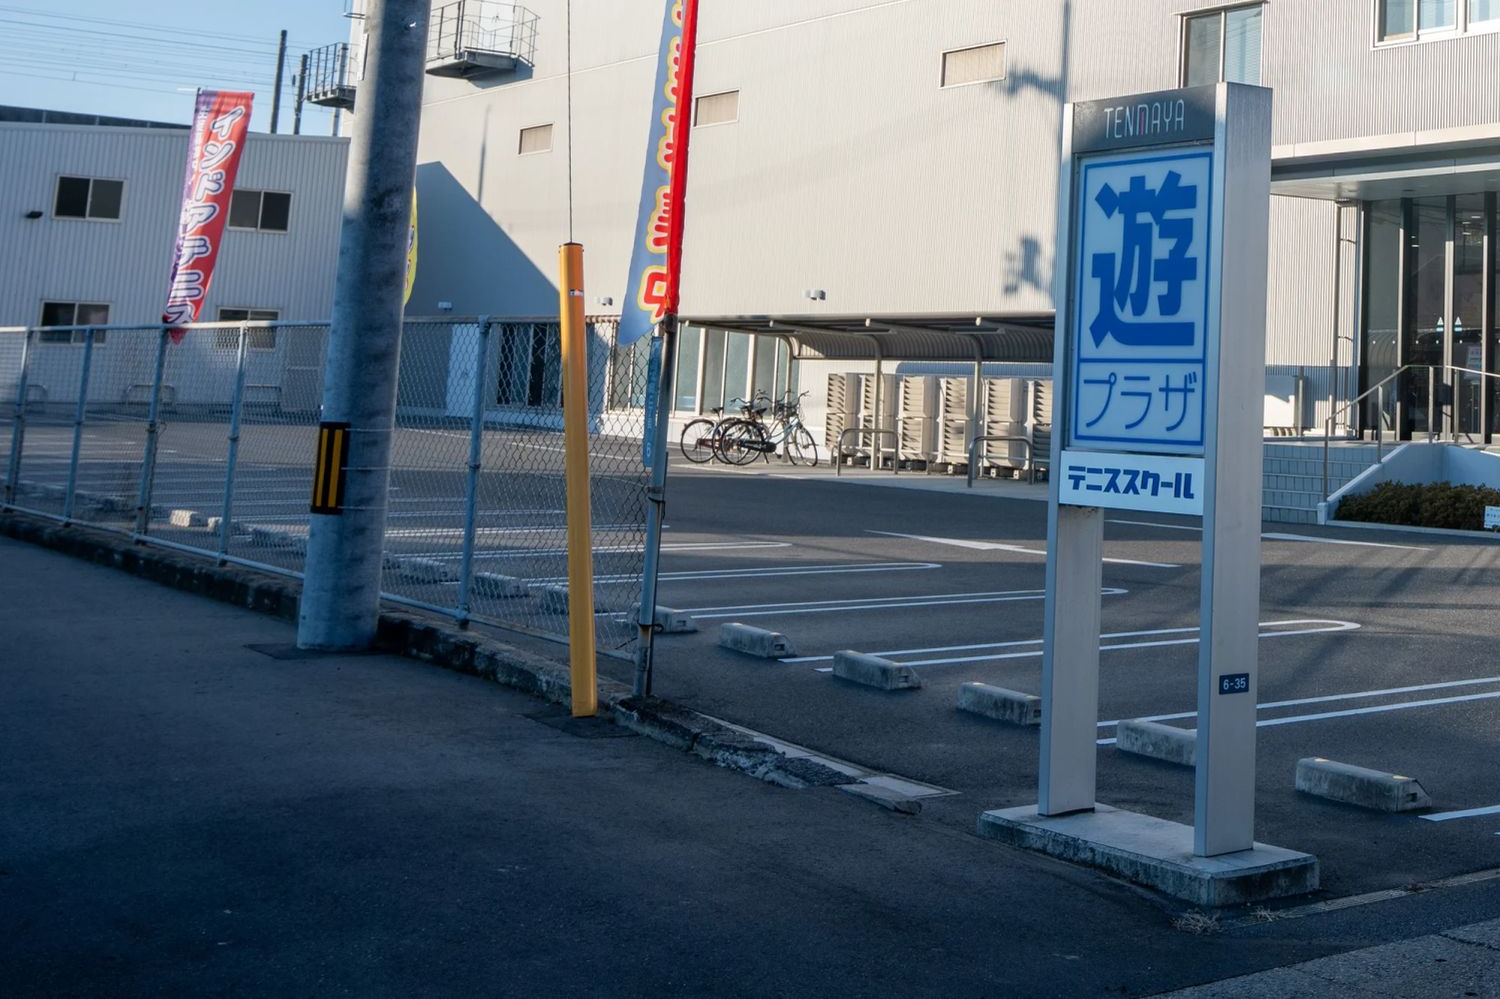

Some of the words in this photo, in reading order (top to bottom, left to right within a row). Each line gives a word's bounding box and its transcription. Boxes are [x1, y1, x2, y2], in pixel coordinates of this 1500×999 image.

[1103, 98, 1185, 139] TENMAYA
[1089, 170, 1198, 349] 遊
[1083, 371, 1197, 432] プラザ
[1068, 465, 1195, 500] テニススクール
[1223, 677, 1246, 690] 6-35
